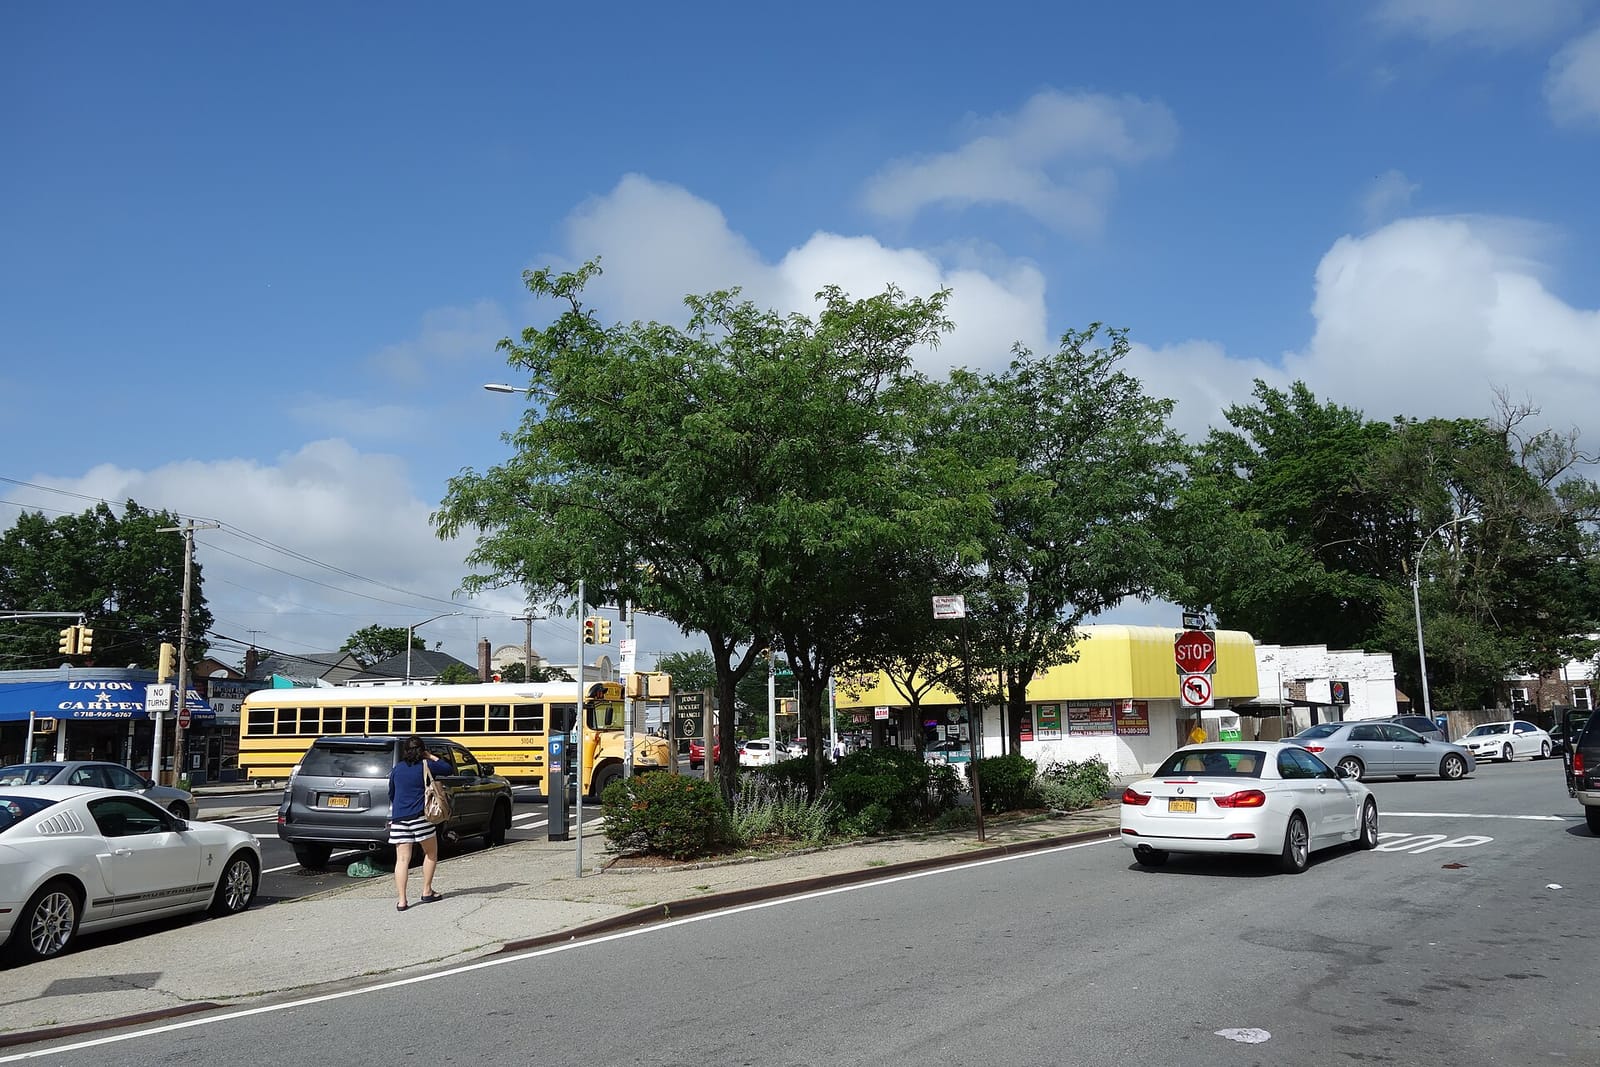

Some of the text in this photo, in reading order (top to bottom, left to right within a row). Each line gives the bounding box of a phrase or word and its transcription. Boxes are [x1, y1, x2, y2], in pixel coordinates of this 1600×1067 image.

[1177, 643, 1212, 660] STOP
[68, 681, 133, 691] UNION
[153, 688, 164, 697] NO
[58, 701, 144, 710] CARPET
[147, 698, 169, 707] TURNS
[213, 702, 225, 712] AID
[552, 743, 560, 754] P
[142, 886, 191, 899] MUSTANG
